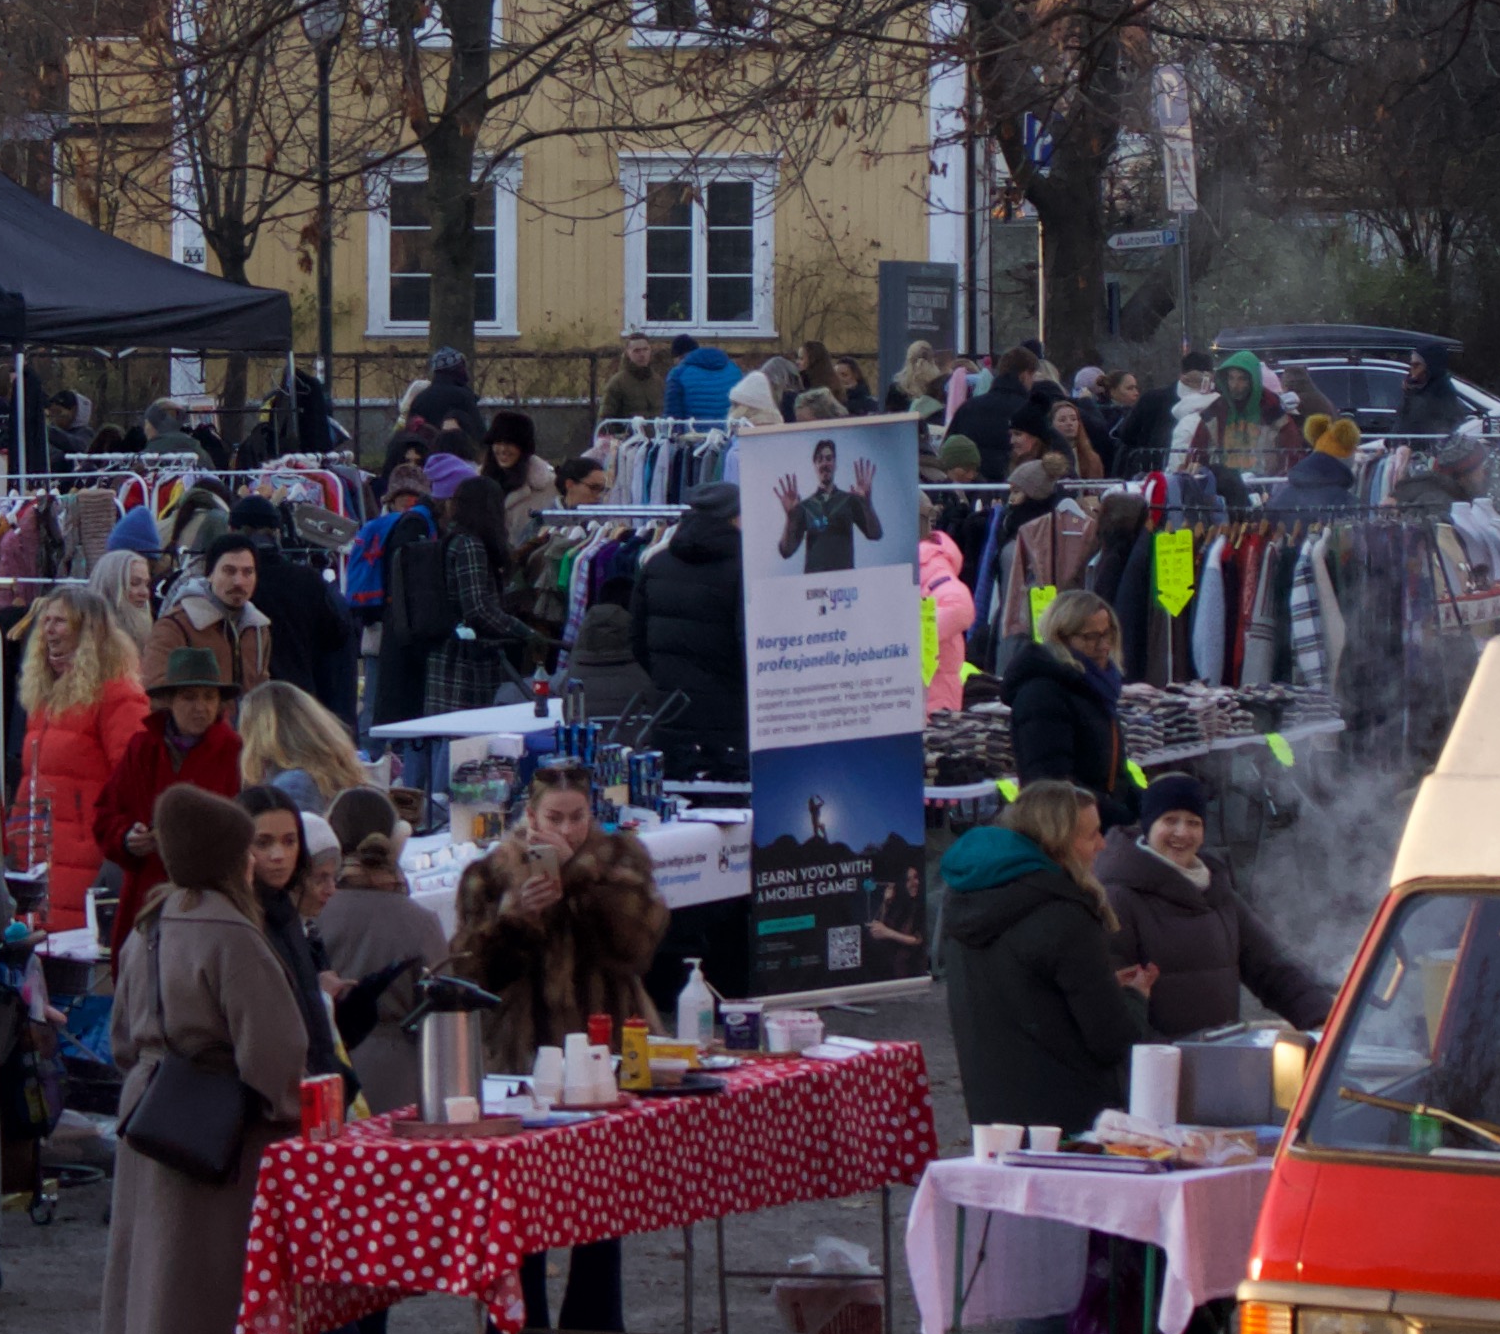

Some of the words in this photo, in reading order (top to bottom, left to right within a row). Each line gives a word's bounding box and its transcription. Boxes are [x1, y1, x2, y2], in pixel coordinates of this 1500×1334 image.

[1116, 233, 1160, 247] Automat
[756, 635, 803, 651] Norges
[806, 628, 847, 644] eneste
[756, 649, 841, 676] profesjonelle
[842, 643, 910, 668] jojobutikk
[756, 869, 798, 887] LEARN
[800, 864, 837, 880] YOYO
[839, 859, 873, 875] WITH
[765, 882, 815, 901] MOBILE
[816, 877, 858, 895] GAME!
